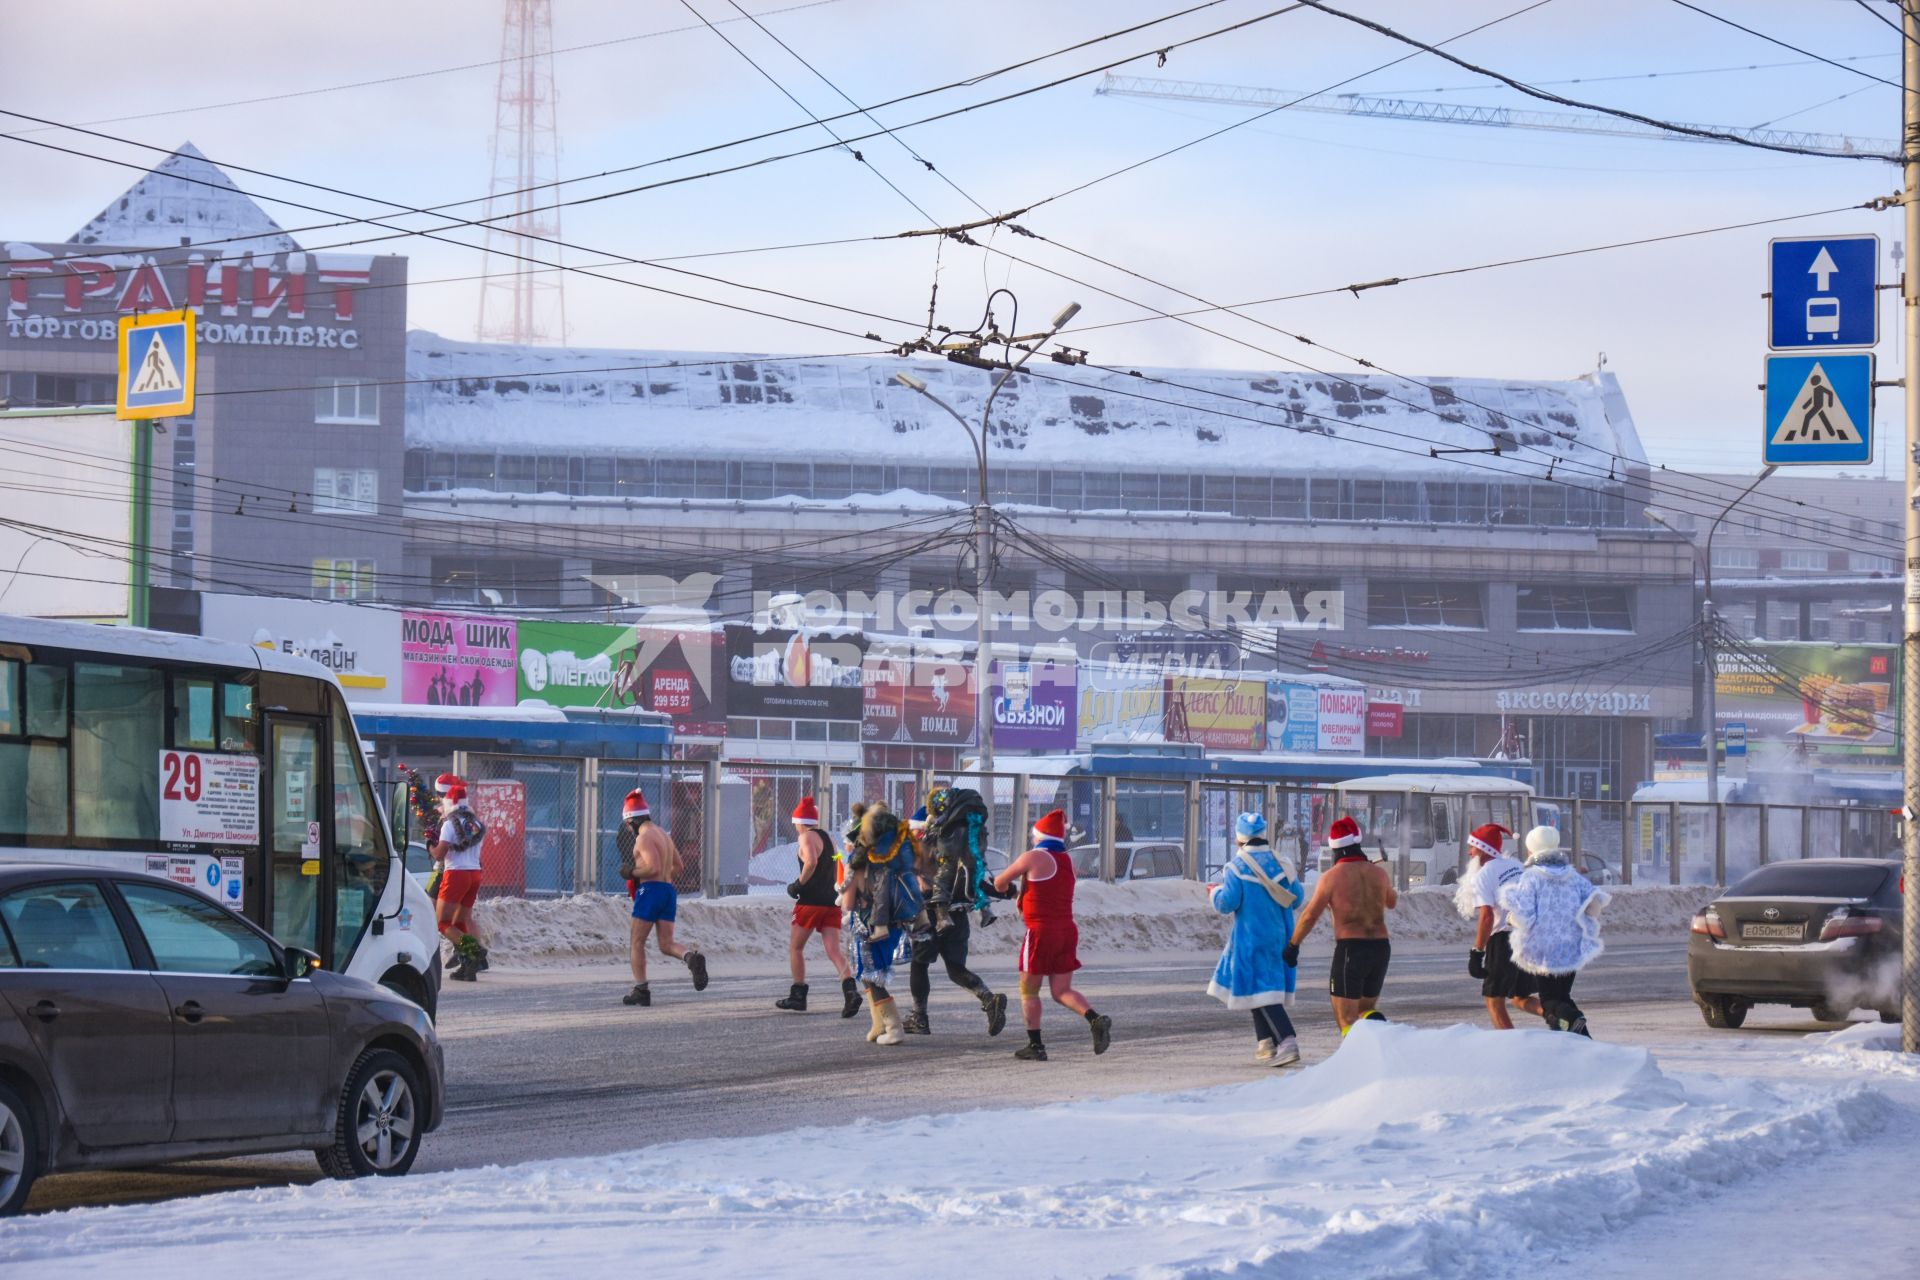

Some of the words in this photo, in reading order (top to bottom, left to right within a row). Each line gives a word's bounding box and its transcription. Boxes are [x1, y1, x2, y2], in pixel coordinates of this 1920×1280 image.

[7, 253, 371, 321] ГРАНИТ
[402, 619, 454, 648] МОДА
[466, 624, 511, 650] ШИК
[403, 652, 439, 662] МАГАЗИН
[482, 657, 514, 668] ОДЕЖДЫ
[1717, 663, 1739, 674] ДЛЯ
[654, 678, 689, 692] АРЕНДА
[654, 696, 668, 706] 299
[670, 696, 679, 707] 55
[681, 696, 690, 707] 27
[1319, 693, 1364, 717] ЛОМБАРД
[1496, 690, 1650, 716] аксессуары
[921, 717, 958, 735] НОМАД
[1331, 735, 1352, 745] САЛОН
[163, 752, 201, 802] 29
[182, 828, 192, 837] Ул.
[194, 829, 224, 840] Дмитрия
